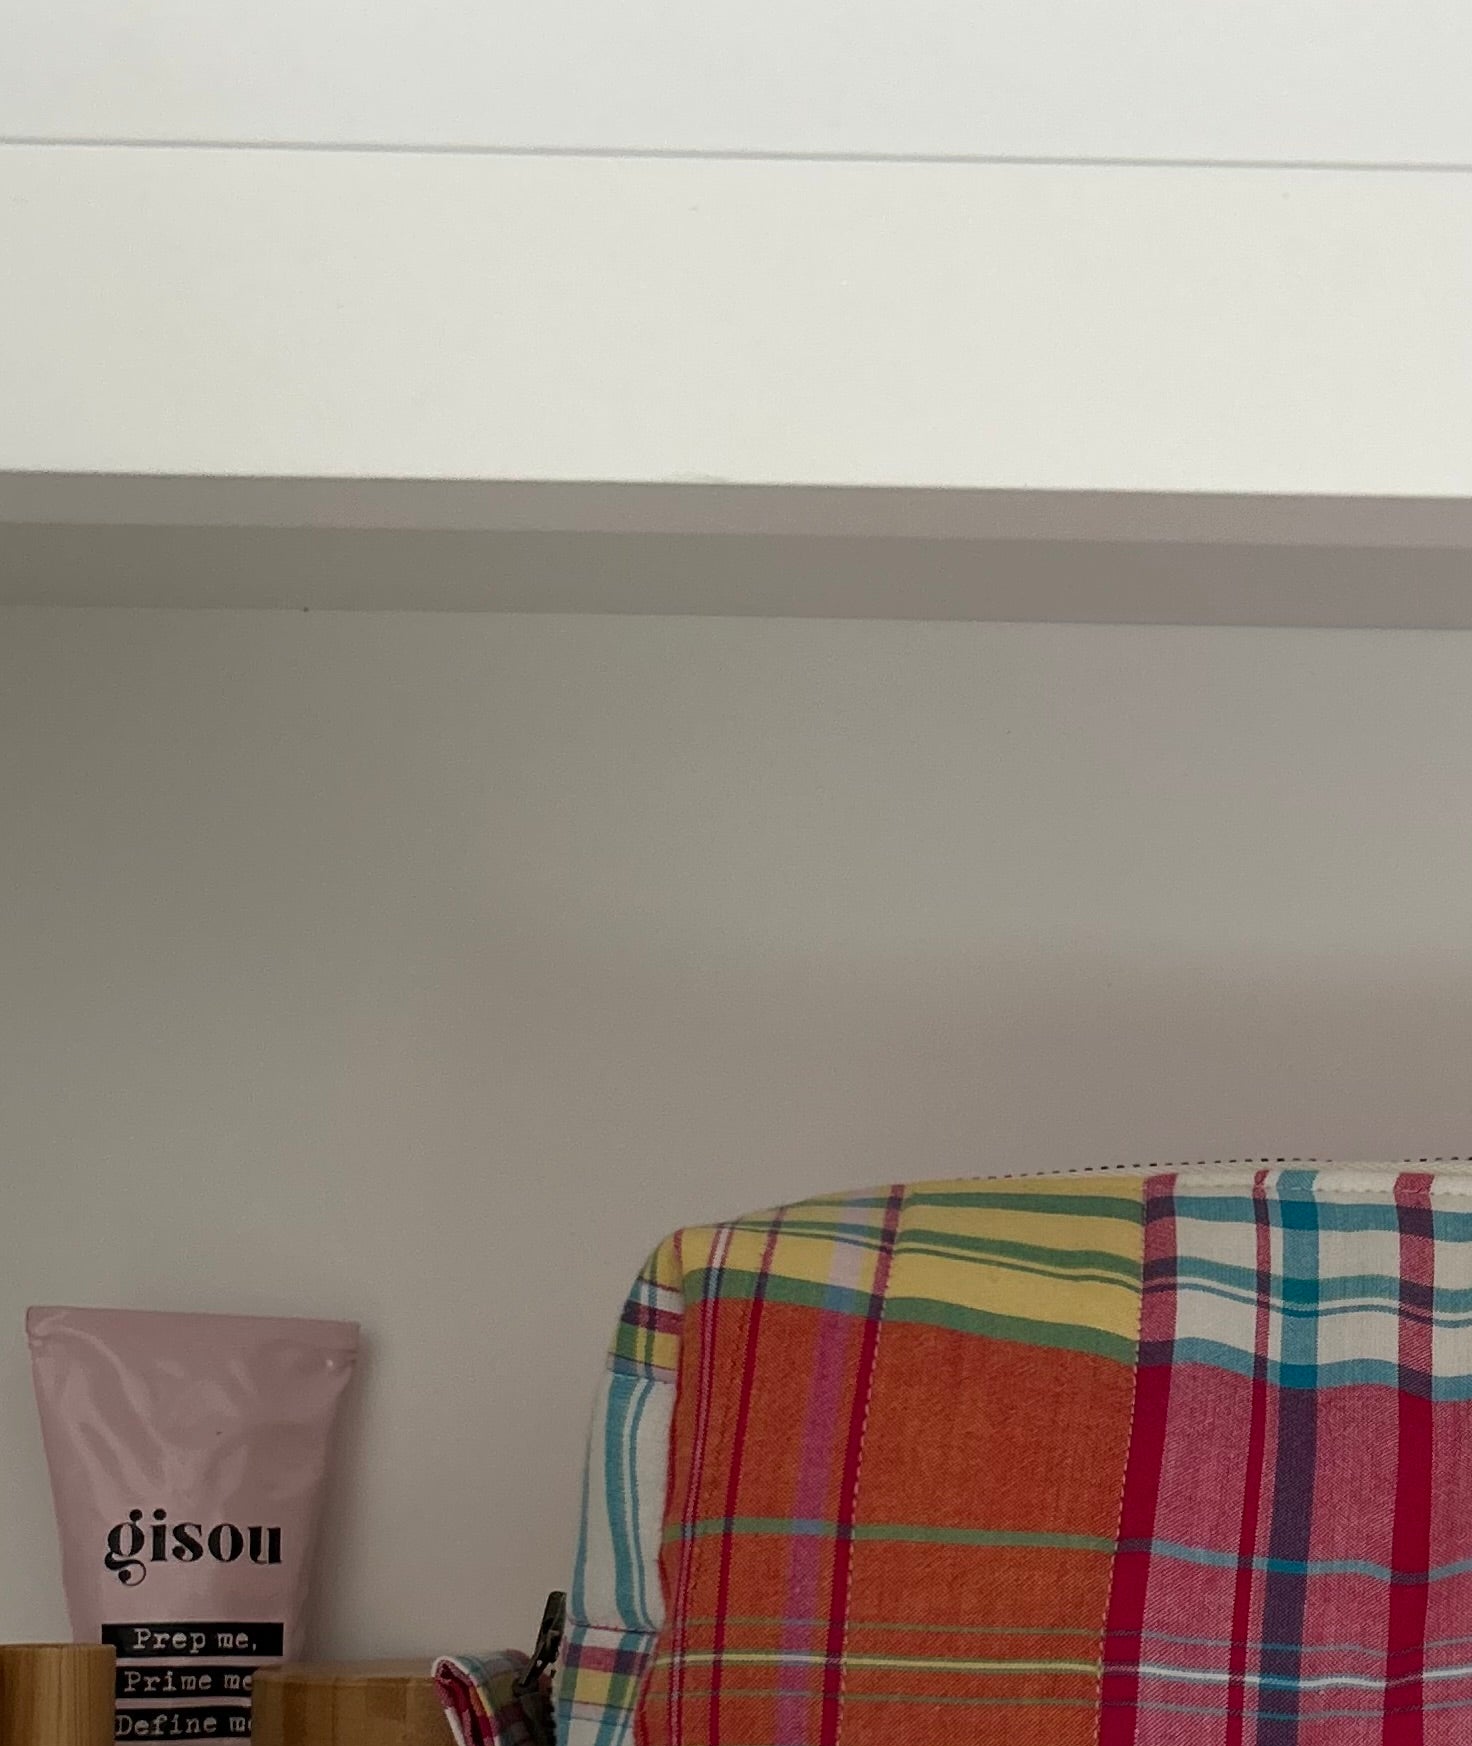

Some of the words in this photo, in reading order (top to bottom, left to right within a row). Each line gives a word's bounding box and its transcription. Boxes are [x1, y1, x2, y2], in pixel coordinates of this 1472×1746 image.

[104, 1508, 282, 1586] gisou
[133, 1628, 206, 1653] Prep
[217, 1632, 257, 1651] me,
[124, 1671, 213, 1692] Prime
[116, 1714, 217, 1736] Define
